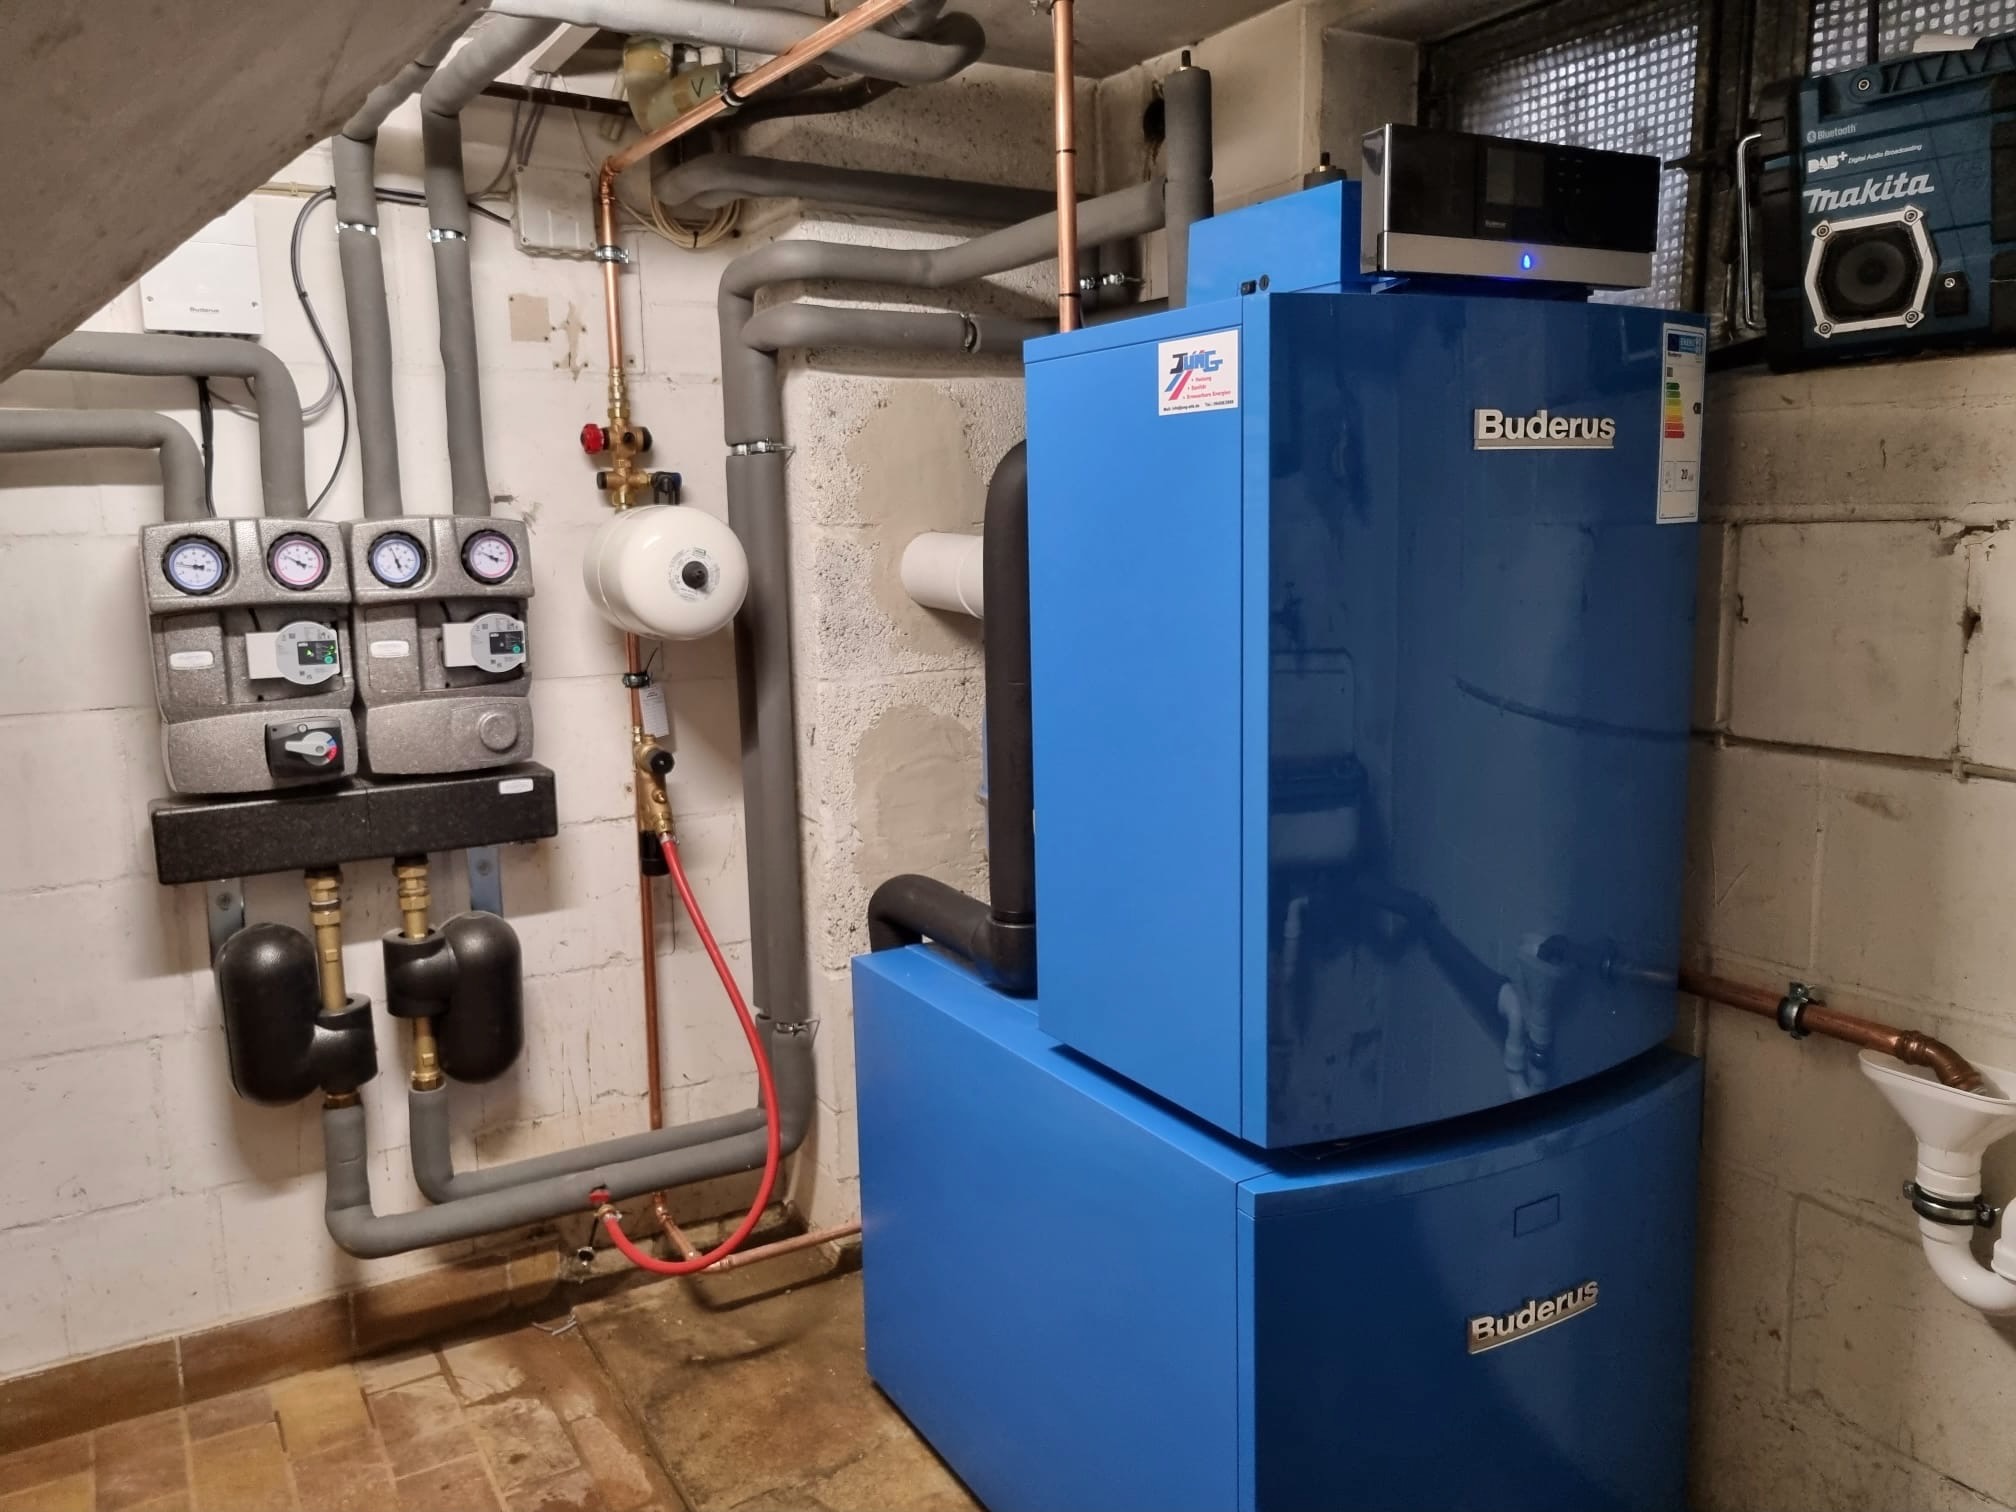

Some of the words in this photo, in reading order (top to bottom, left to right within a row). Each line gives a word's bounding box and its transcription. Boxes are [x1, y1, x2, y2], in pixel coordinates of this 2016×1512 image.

[1817, 123, 1857, 140] Bluetooth
[1475, 408, 1616, 441] Buderus
[1471, 1280, 1599, 1341] Buderus
